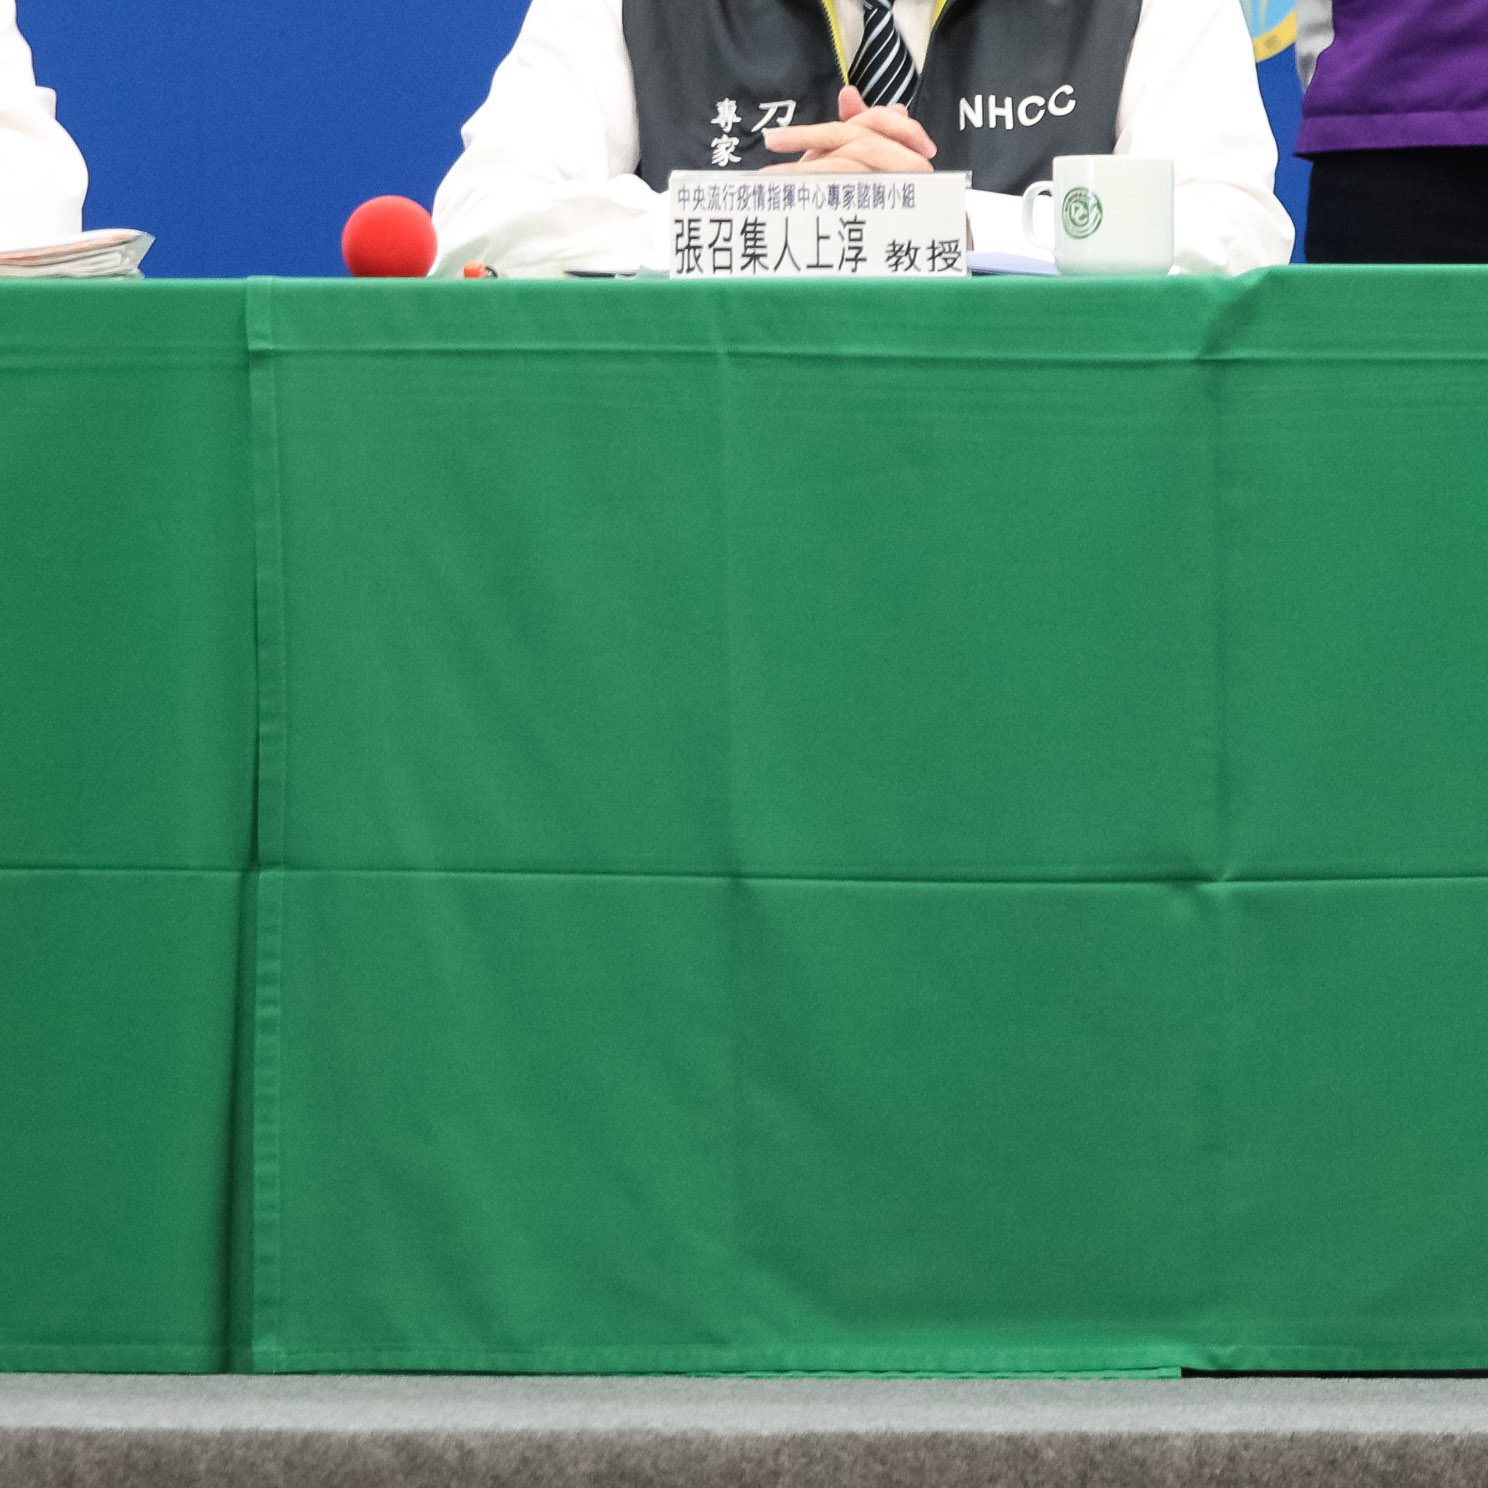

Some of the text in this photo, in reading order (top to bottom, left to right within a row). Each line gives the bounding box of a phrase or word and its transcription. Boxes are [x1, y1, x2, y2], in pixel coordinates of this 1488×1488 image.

[711, 97, 742, 167] 專家
[959, 84, 1077, 131] NHCC
[677, 182, 917, 212] 中央流行疫情指揮中心專家諮詢小組
[674, 214, 963, 275] 張召集人上淳 教授
